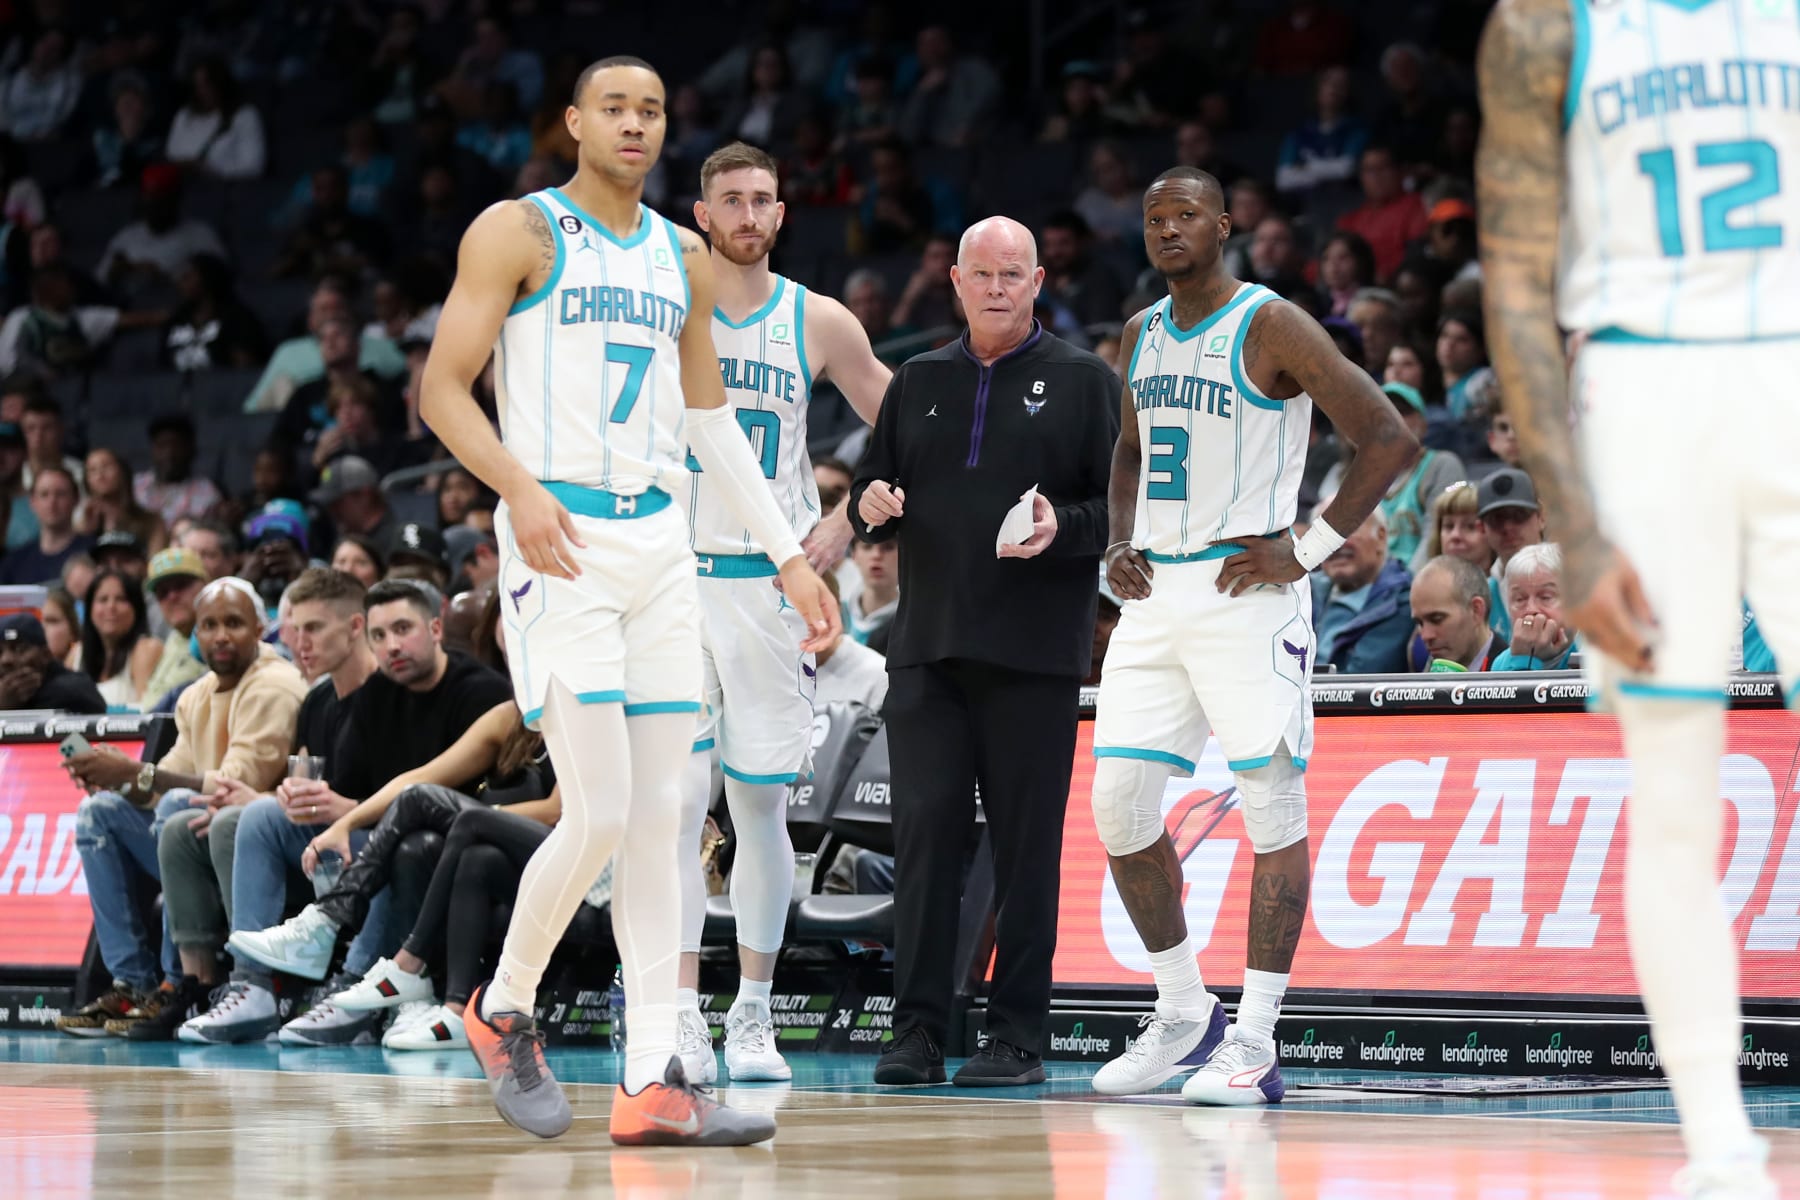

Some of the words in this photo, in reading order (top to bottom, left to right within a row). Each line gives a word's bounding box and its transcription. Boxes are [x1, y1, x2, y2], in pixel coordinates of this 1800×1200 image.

[1592, 59, 1800, 135] CHARLOTT
[1637, 139, 1783, 257] 12
[561, 217, 580, 234] 6
[605, 342, 656, 424] 7
[1032, 380, 1046, 395] 6
[1147, 426, 1190, 501] 3
[1386, 687, 1436, 701] GATORADE
[1467, 686, 1518, 700] GATORADE
[832, 1009, 853, 1029] 24
[849, 1029, 882, 1042] GROUP
[1050, 1033, 1111, 1056] lendingtree
[1279, 1040, 1344, 1063] lendingtree
[1360, 1041, 1425, 1065] lendingtree
[1442, 1043, 1508, 1067] lendingtree
[1525, 1044, 1593, 1068] lendingtree
